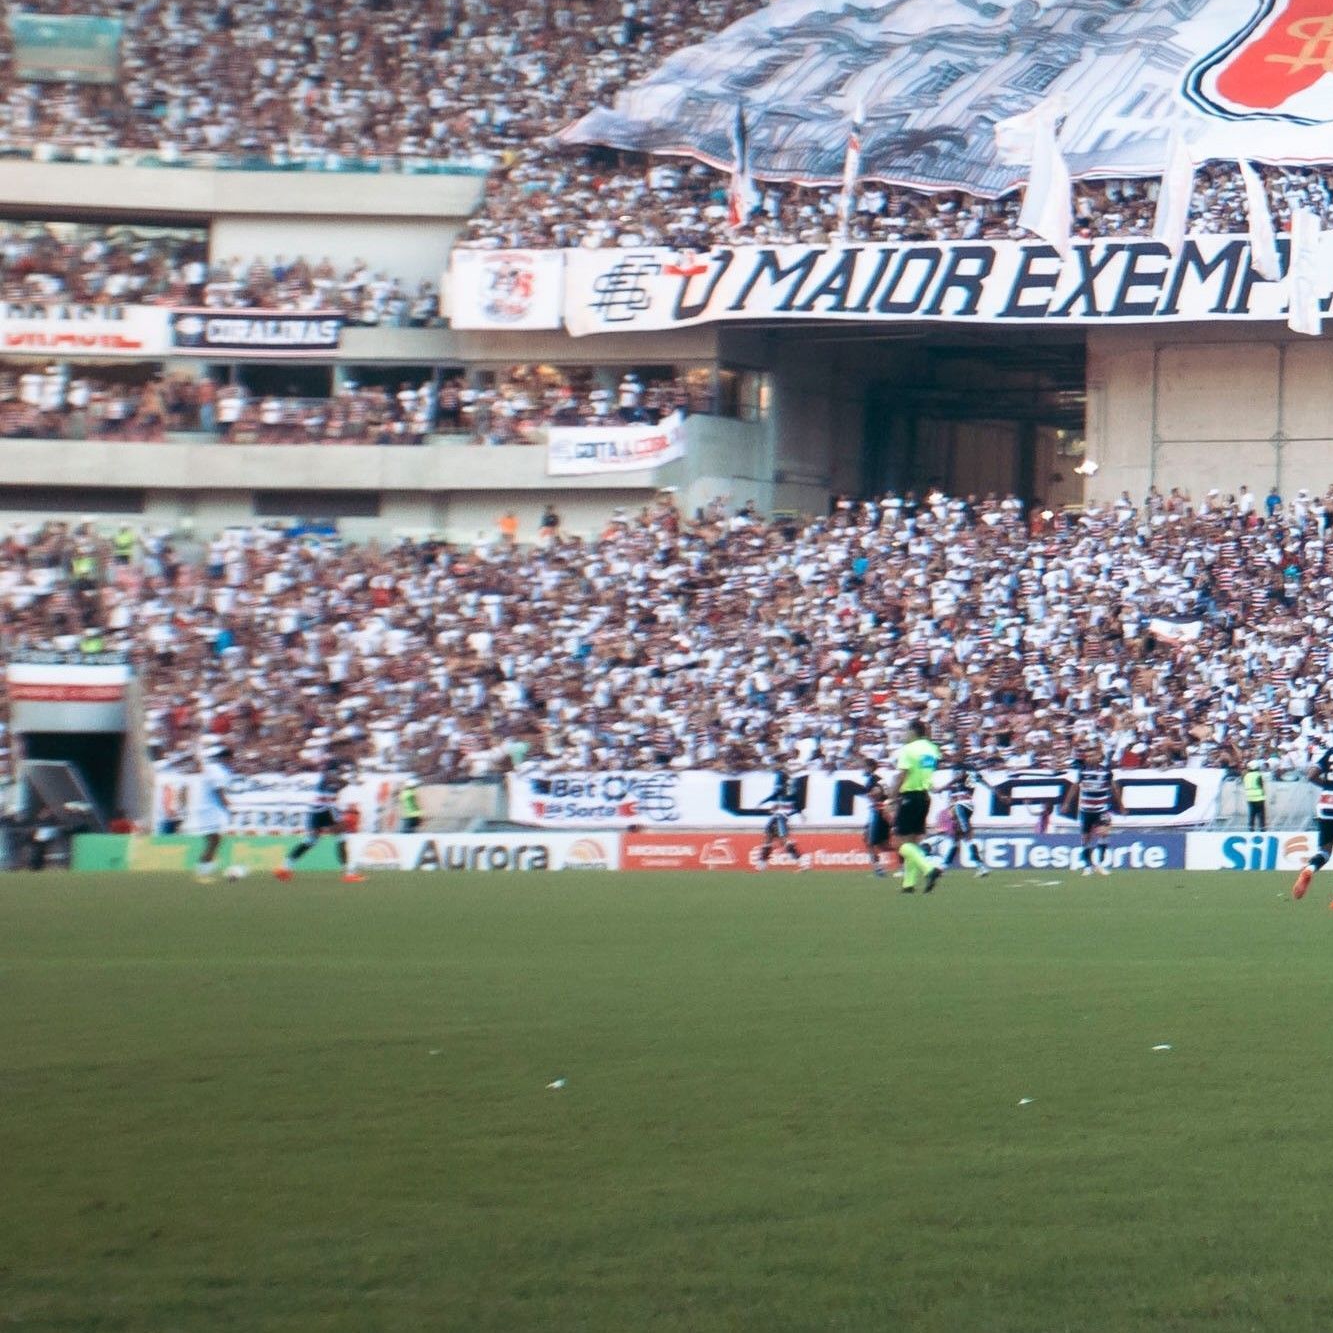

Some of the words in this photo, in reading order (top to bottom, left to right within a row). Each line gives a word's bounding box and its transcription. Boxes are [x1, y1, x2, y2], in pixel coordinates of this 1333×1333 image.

[728, 245, 996, 316] MAIOR
[415, 839, 549, 870] Aurora
[1222, 835, 1279, 870] Sil
